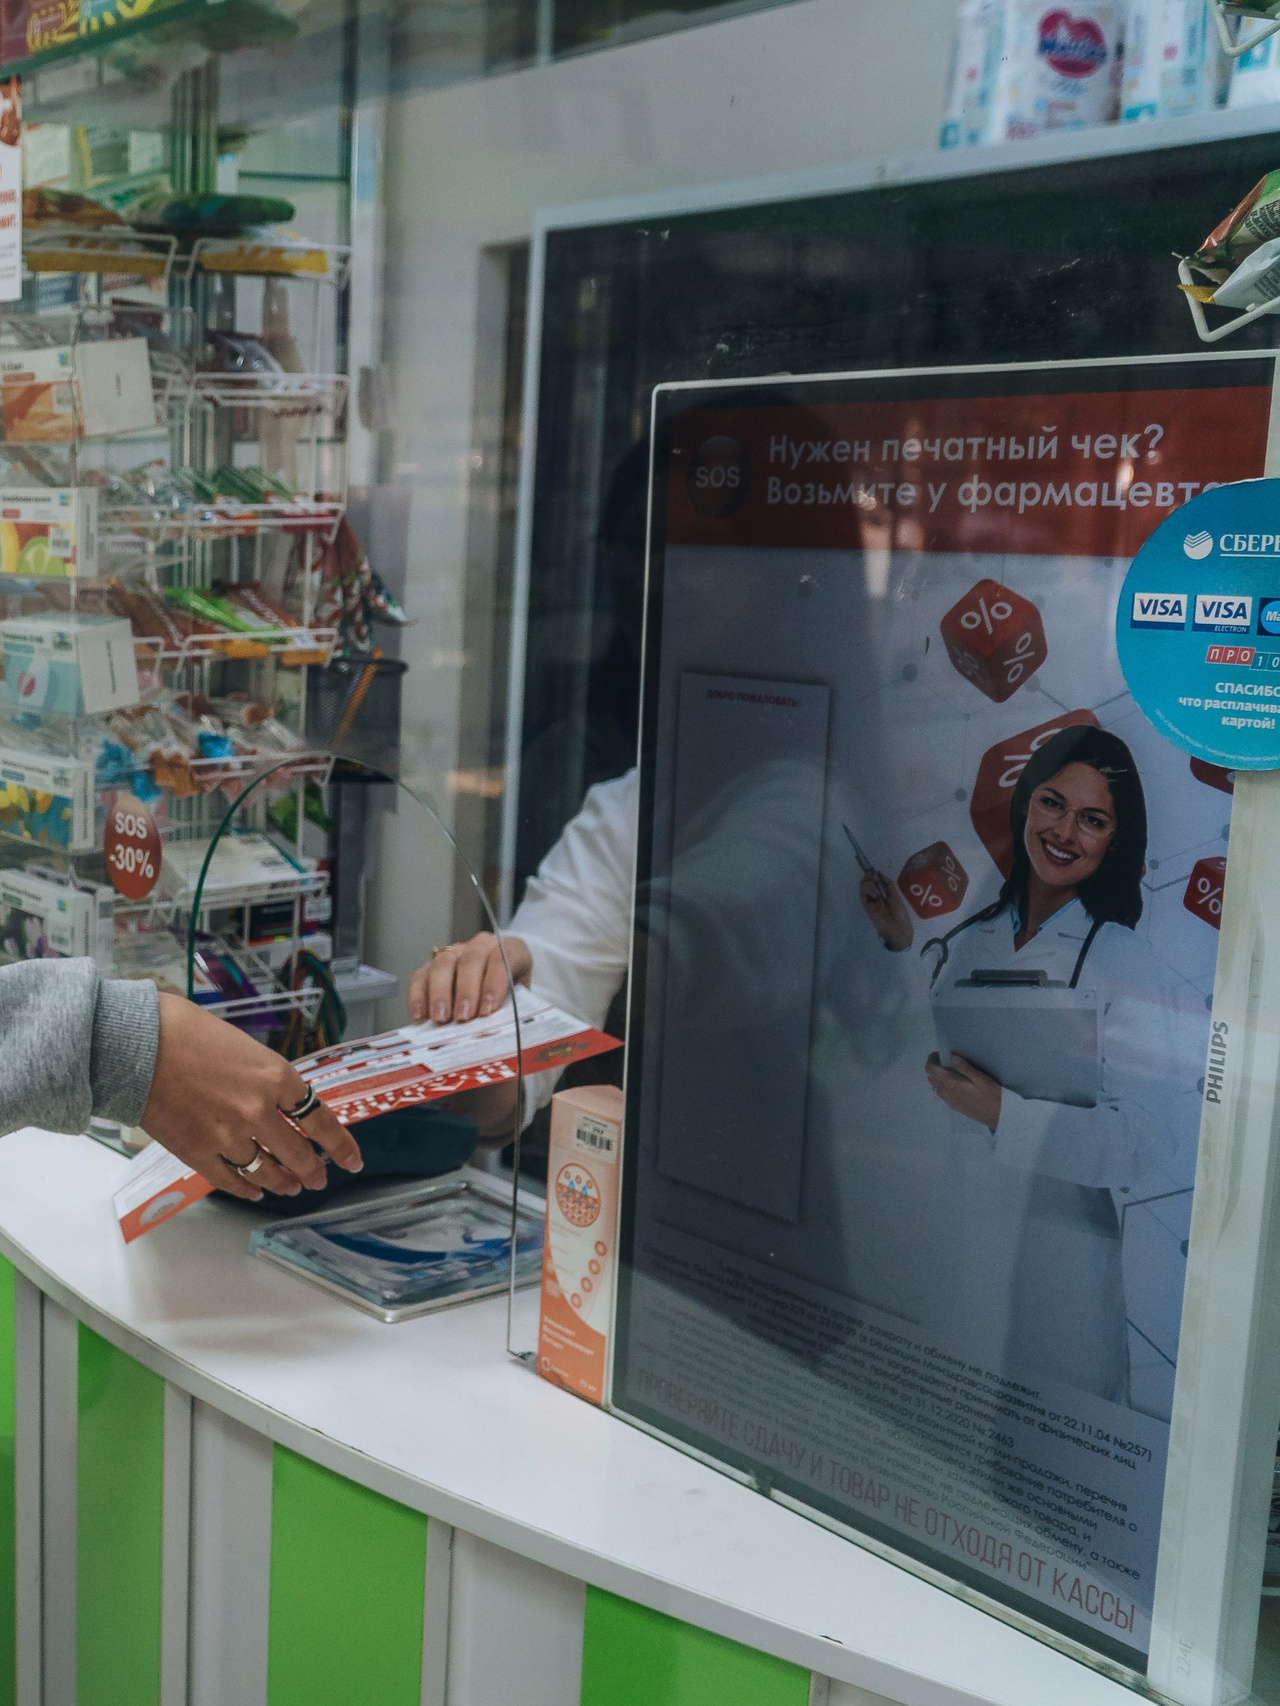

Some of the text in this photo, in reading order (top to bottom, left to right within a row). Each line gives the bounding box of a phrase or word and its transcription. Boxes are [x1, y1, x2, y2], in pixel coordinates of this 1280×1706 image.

[768, 423, 1165, 467] Нужен печатный чек?
[695, 465, 741, 488] SOS
[767, 474, 917, 506] Возьмите
[927, 485, 947, 513] у
[1139, 598, 1183, 617] VISA
[1201, 601, 1248, 620] VISA
[1214, 625, 1248, 633] ELECTRON
[1178, 697, 1201, 708] что
[1221, 716, 1276, 729] картой!
[115, 811, 148, 839] SOS
[108, 843, 154, 879] -30%
[1206, 1021, 1229, 1104] PHILIPS
[987, 1428, 1014, 1449] 2463
[1037, 1418, 1110, 1459] физических
[1063, 1414, 1111, 1444] 22.11.04
[1025, 1490, 1098, 1531] основными
[1046, 1483, 1125, 1529] потребителя
[1075, 1482, 1128, 1515] перечня
[743, 1416, 806, 1474] СДАЧУ
[827, 1458, 891, 1514] ТОВАР
[893, 1490, 920, 1529] НЕ
[922, 1504, 1014, 1576] ОТХОДЯ
[1016, 1549, 1047, 1591] ОТ
[1051, 1565, 1136, 1634] КАССЫ
[1033, 1508, 1080, 1539] товара,
[1033, 1521, 1086, 1557] обмену,
[1101, 1553, 1141, 1582] также
[1176, 1640, 1194, 1679] 224E
